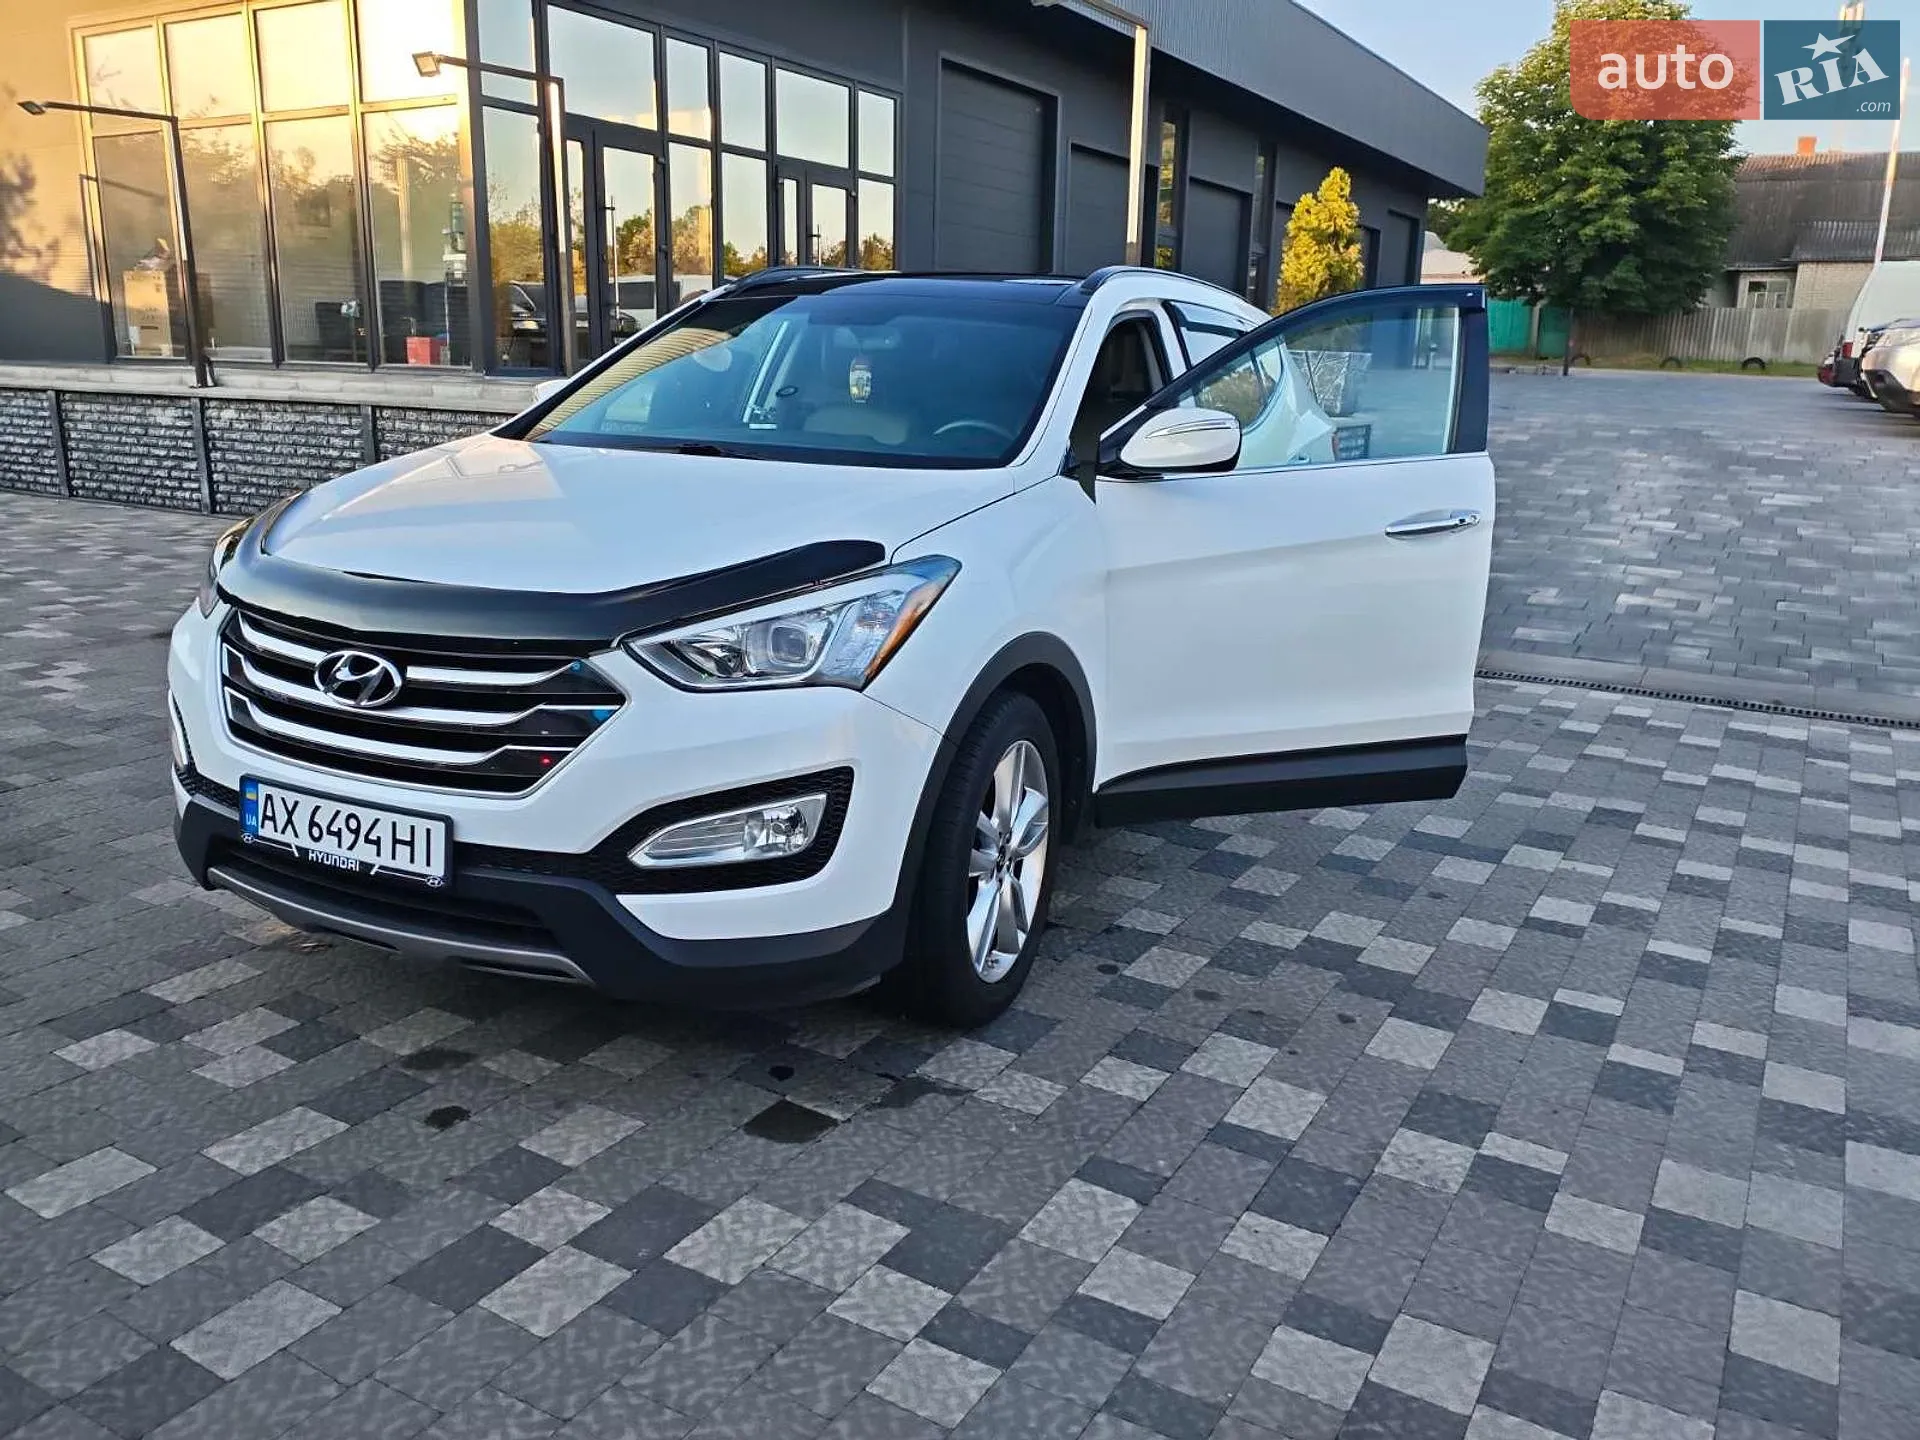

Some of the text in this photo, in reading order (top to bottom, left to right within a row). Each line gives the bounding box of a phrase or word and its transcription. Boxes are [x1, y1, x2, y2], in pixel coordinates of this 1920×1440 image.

[245, 813, 258, 827] UA
[260, 793, 300, 839] AX
[308, 849, 360, 873] HYUNDAI
